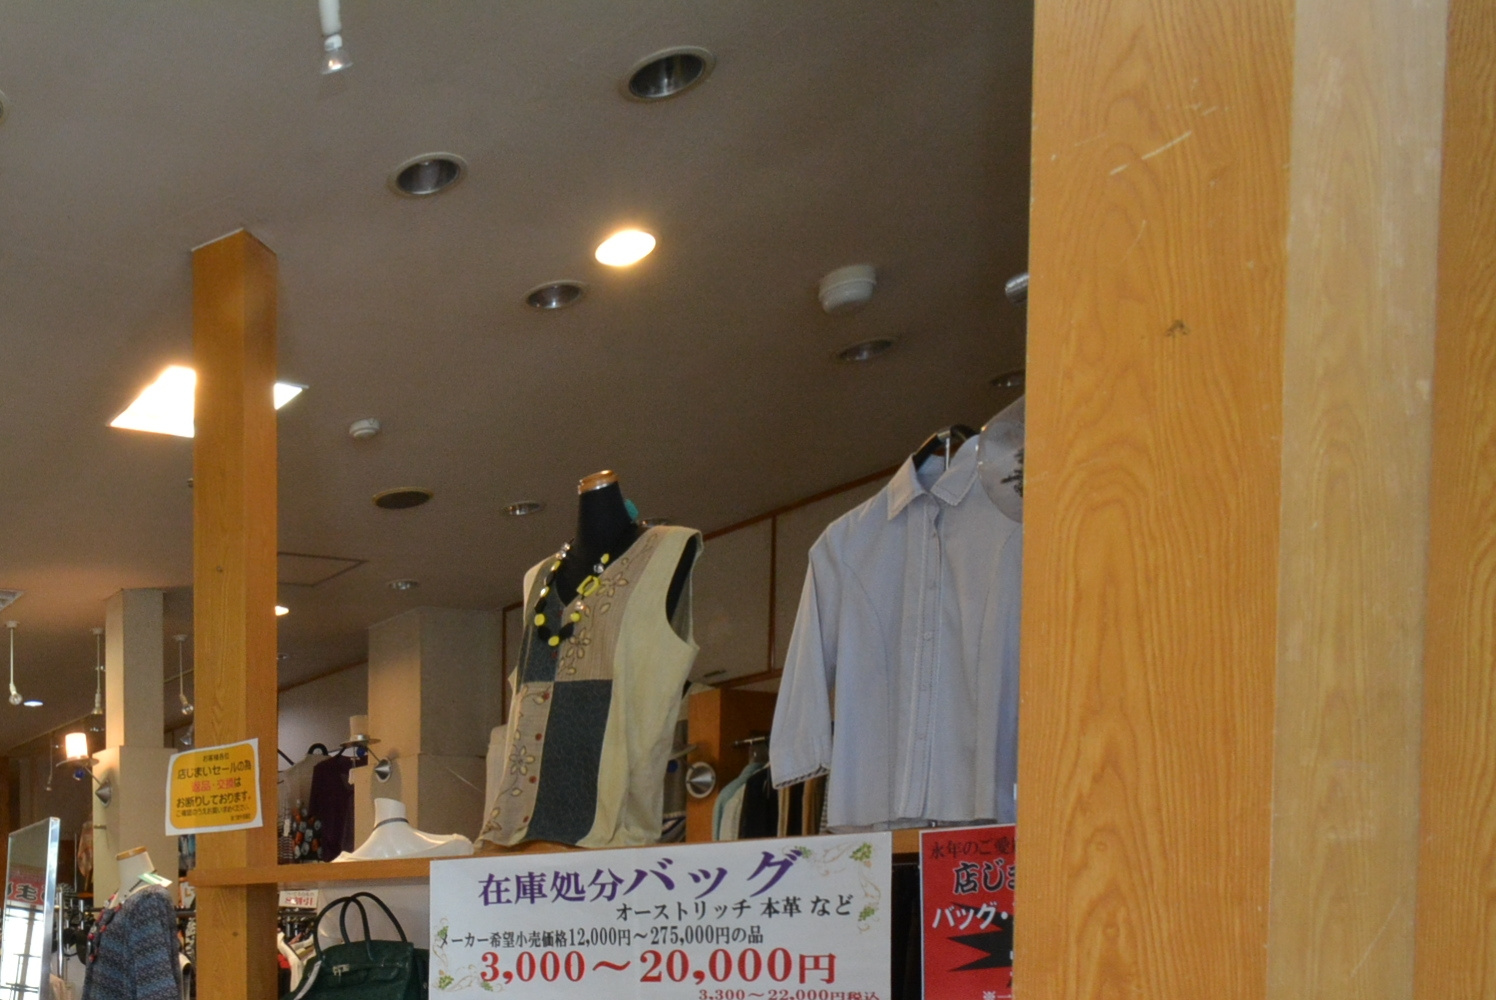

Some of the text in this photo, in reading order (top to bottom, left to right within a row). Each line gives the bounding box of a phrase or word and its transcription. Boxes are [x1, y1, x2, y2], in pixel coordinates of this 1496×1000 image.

[930, 835, 1015, 860] 永年のご愛
[478, 849, 803, 907] 在庫処分バッグ
[616, 894, 854, 922] オーストリッチ 本革 など
[480, 947, 837, 985] 3,000～20,000円
